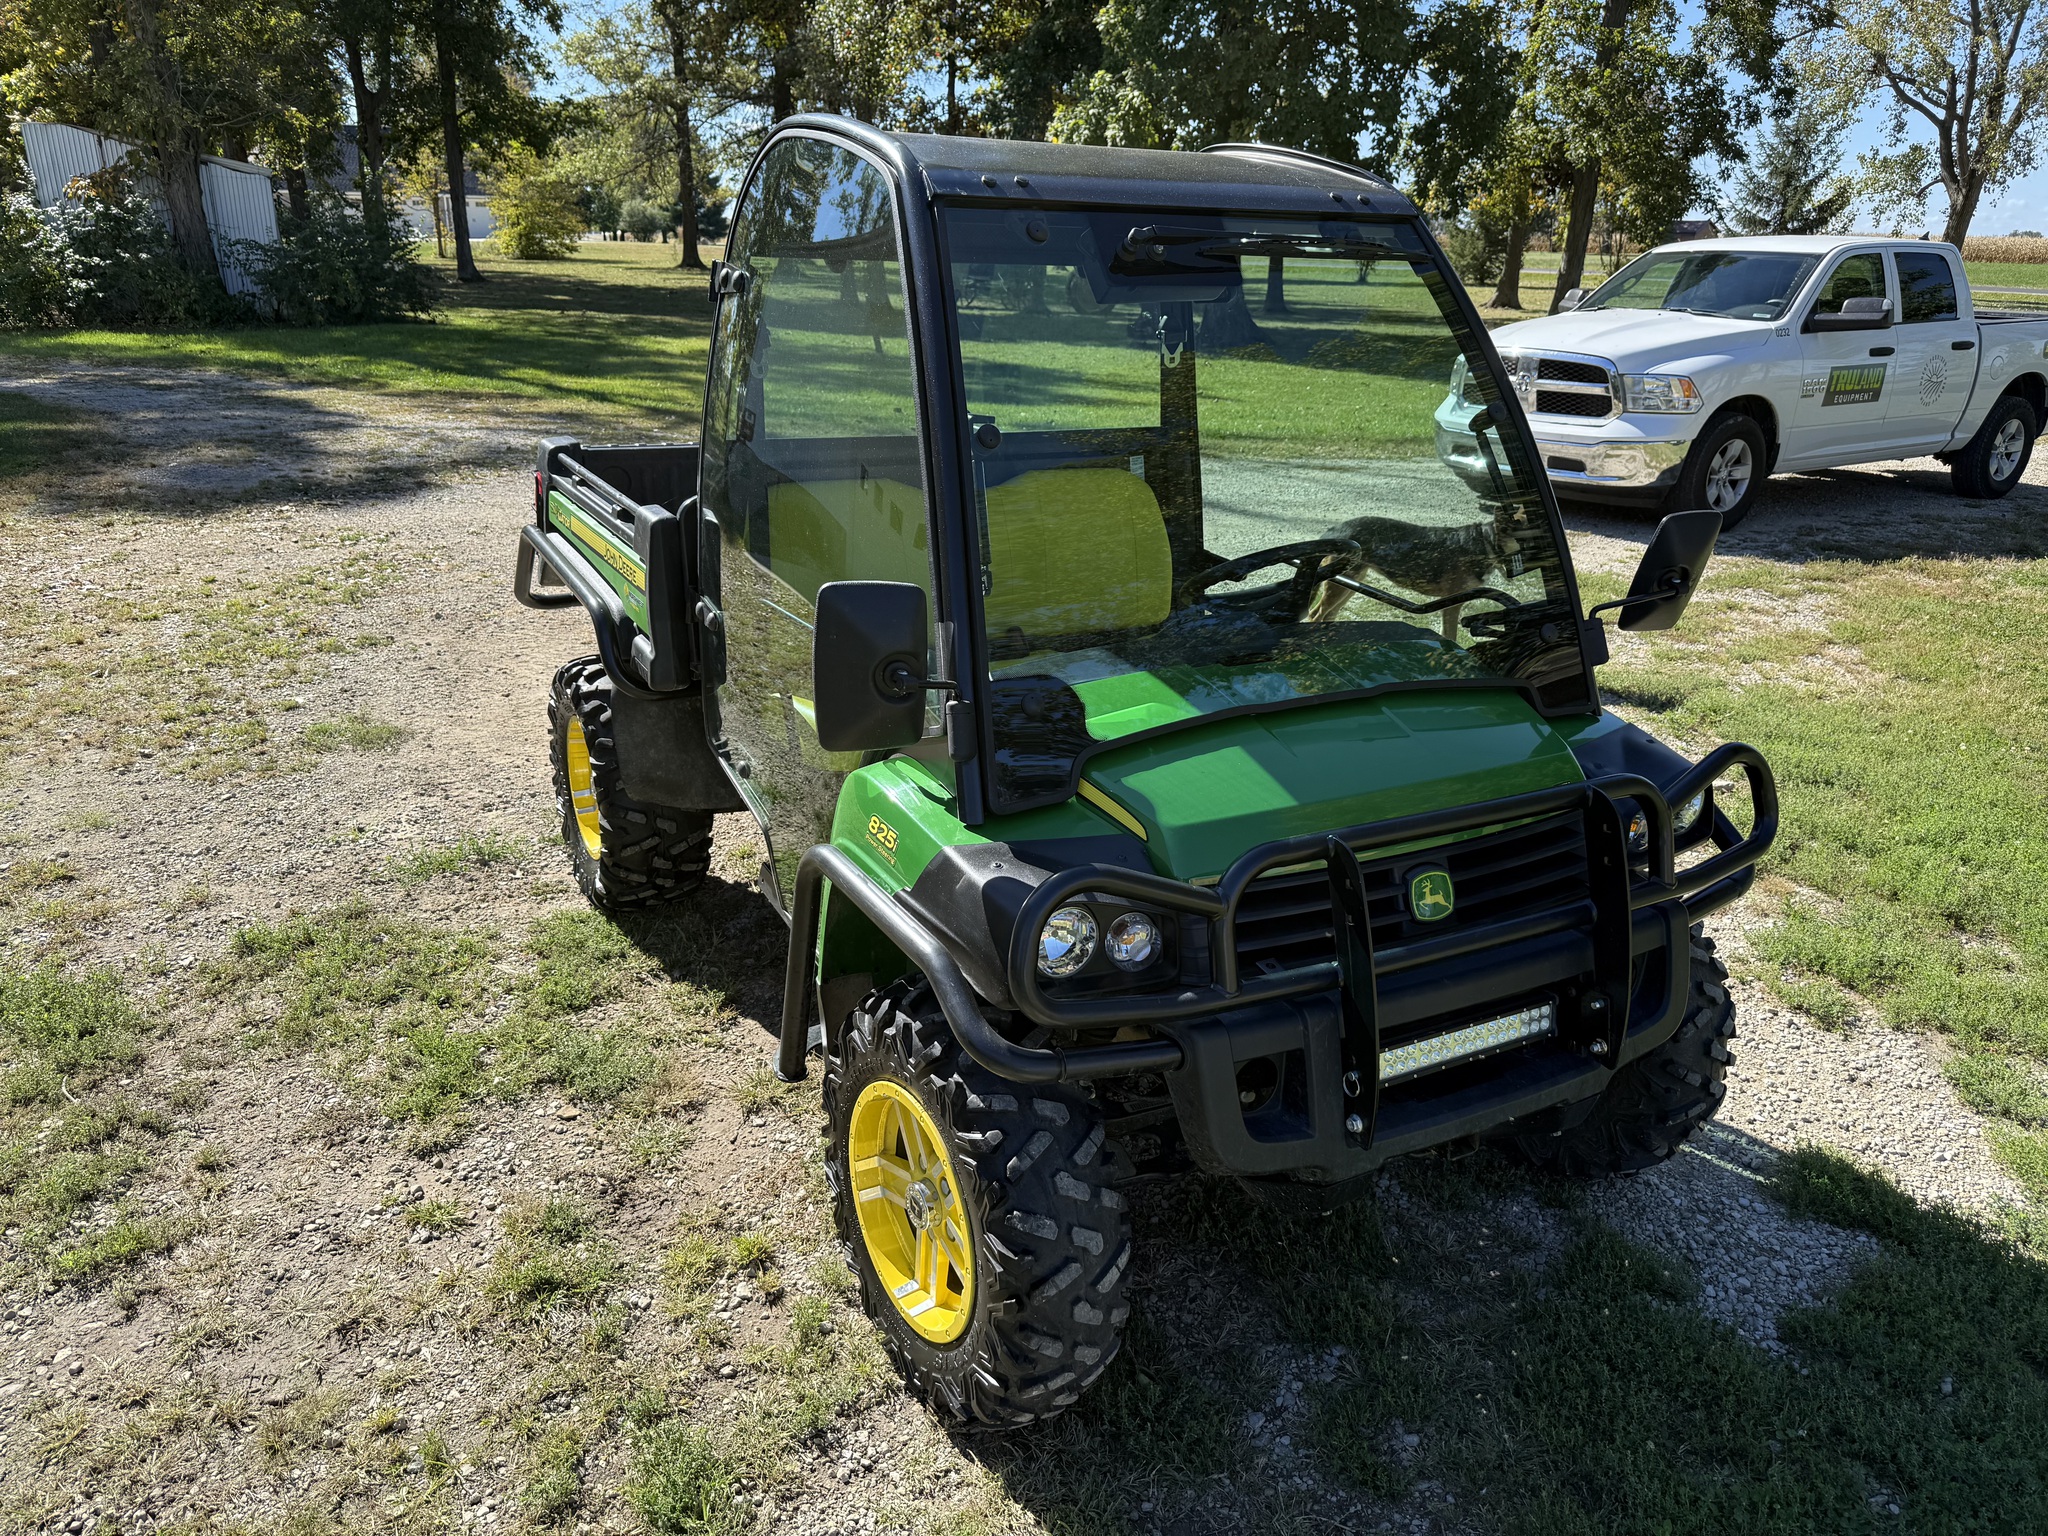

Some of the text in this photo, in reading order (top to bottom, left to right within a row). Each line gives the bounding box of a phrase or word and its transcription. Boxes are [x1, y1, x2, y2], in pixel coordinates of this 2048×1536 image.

[1775, 328, 1790, 337] 0232
[1830, 367, 1884, 392] TRULAND
[1834, 392, 1873, 403] EQUIPMENT
[603, 543, 637, 584] JOHN DEERE
